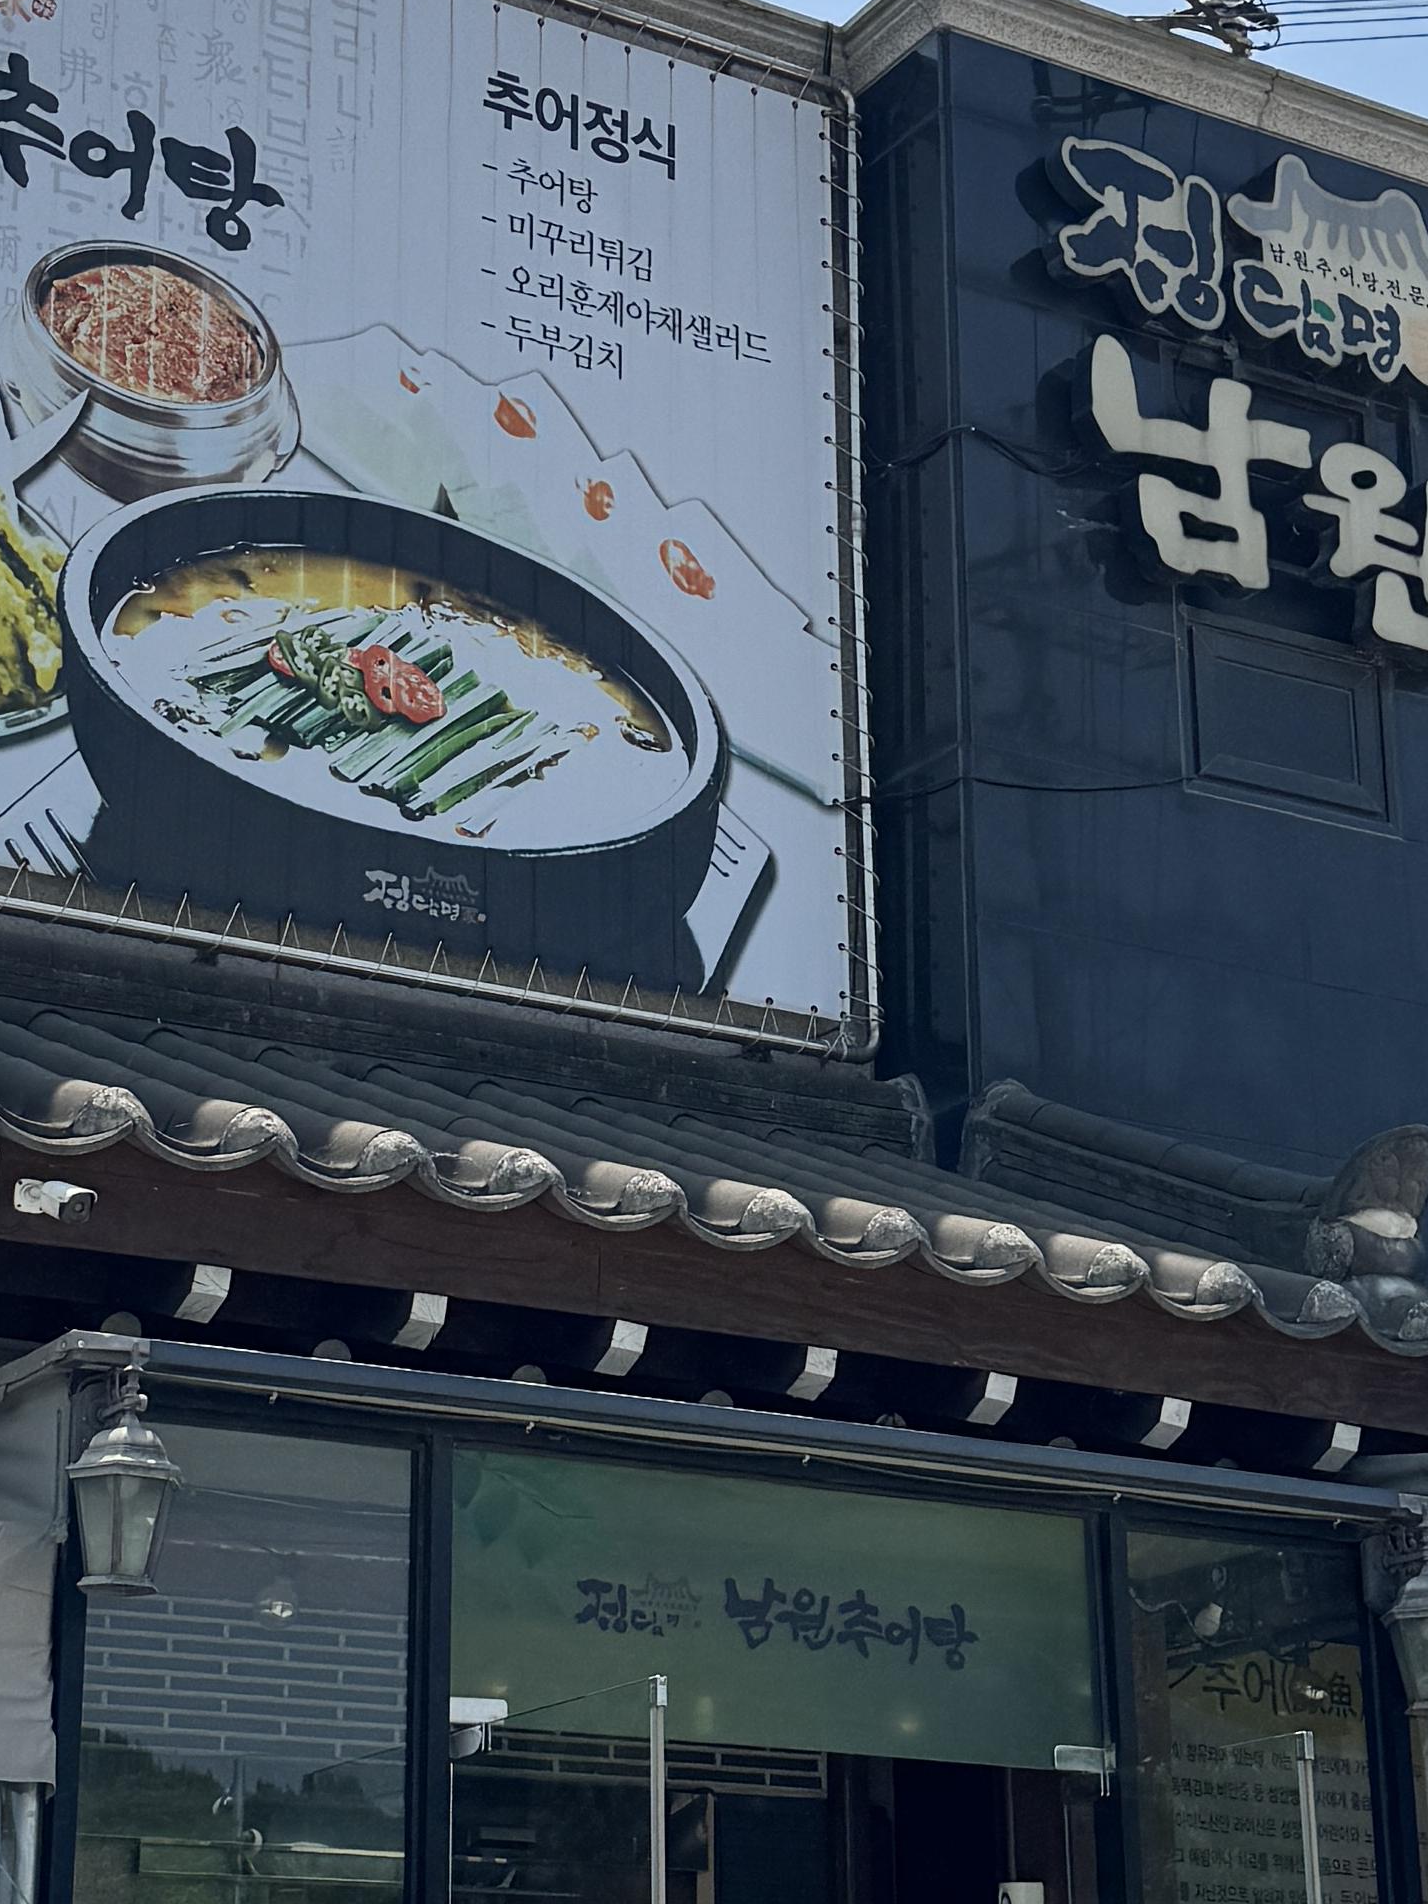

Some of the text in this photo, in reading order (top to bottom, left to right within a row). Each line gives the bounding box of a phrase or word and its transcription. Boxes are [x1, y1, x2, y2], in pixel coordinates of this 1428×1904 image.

[482, 68, 678, 181] 추어정식
[506, 166, 598, 214] 추어탕
[508, 212, 654, 282] 미꾸리튀김
[505, 265, 772, 365] 오리훈제야채샐러드
[505, 315, 625, 381] 두부김치
[724, 1576, 983, 1672] 남원추어탕
